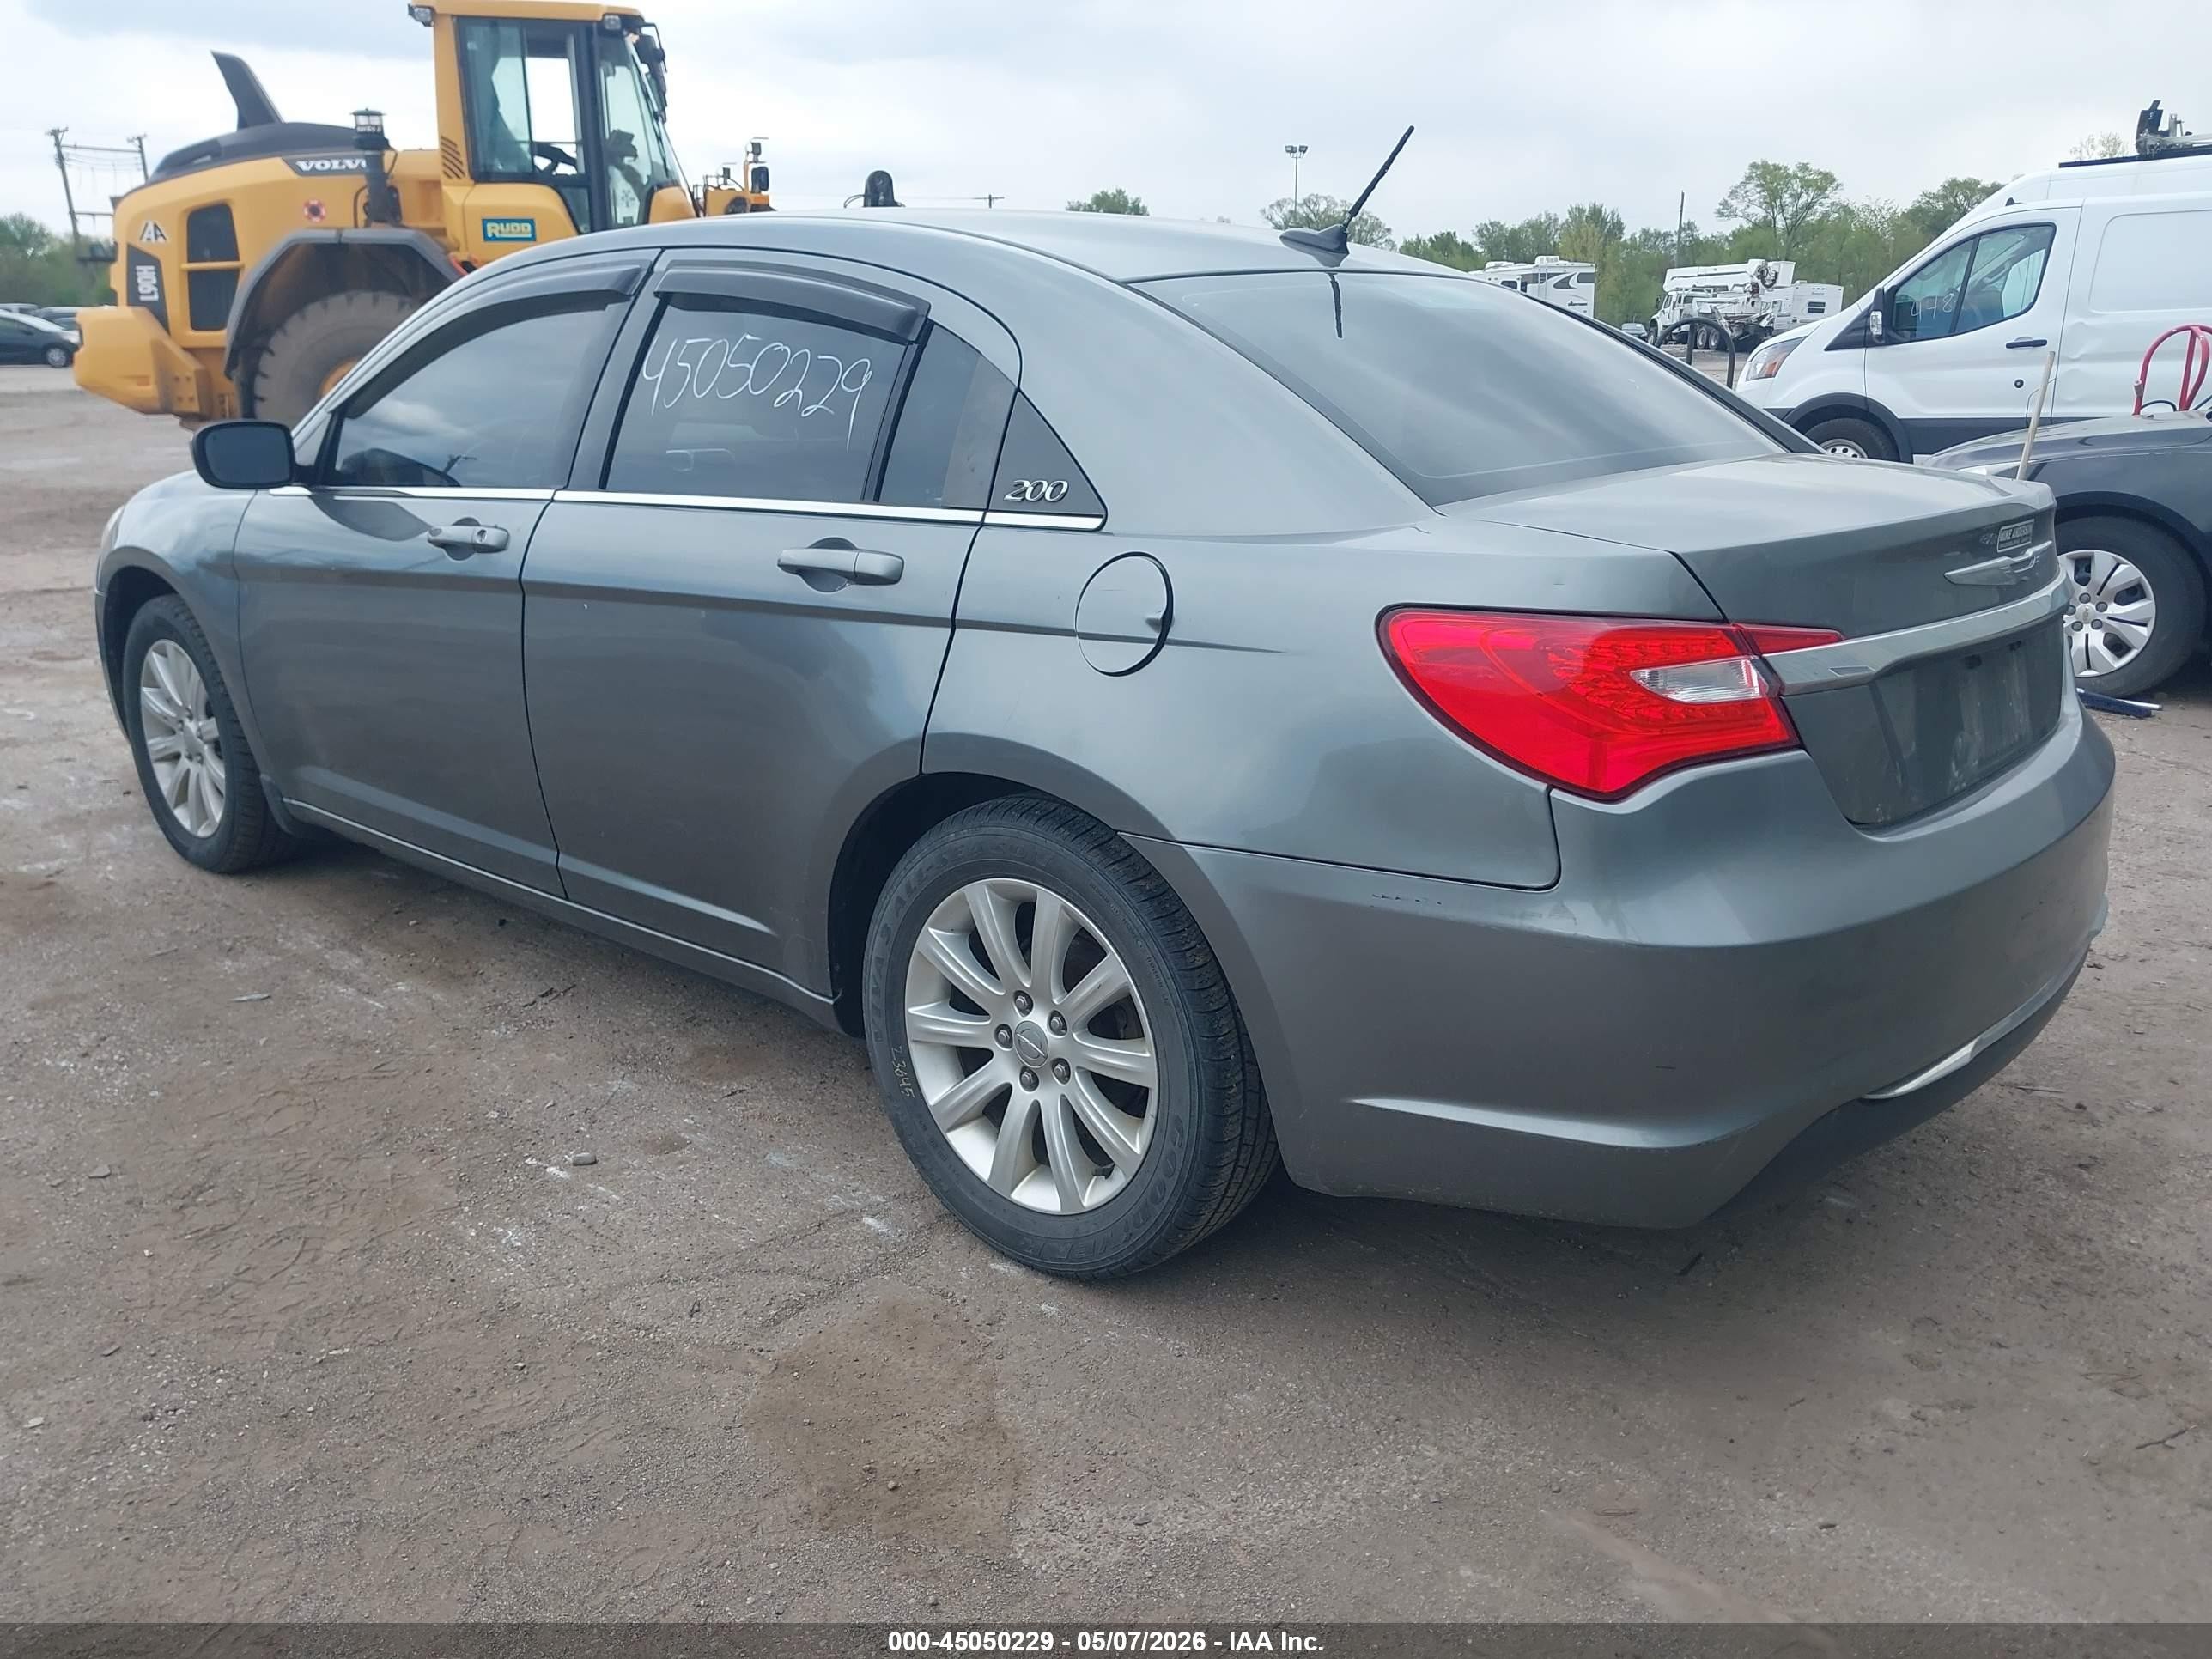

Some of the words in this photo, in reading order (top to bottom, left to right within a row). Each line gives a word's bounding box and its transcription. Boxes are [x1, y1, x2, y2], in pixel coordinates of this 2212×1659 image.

[486, 222, 532, 238] RUDD
[136, 264, 160, 301] L90H
[642, 332, 872, 453] 45050229
[1003, 479, 1069, 502] 200
